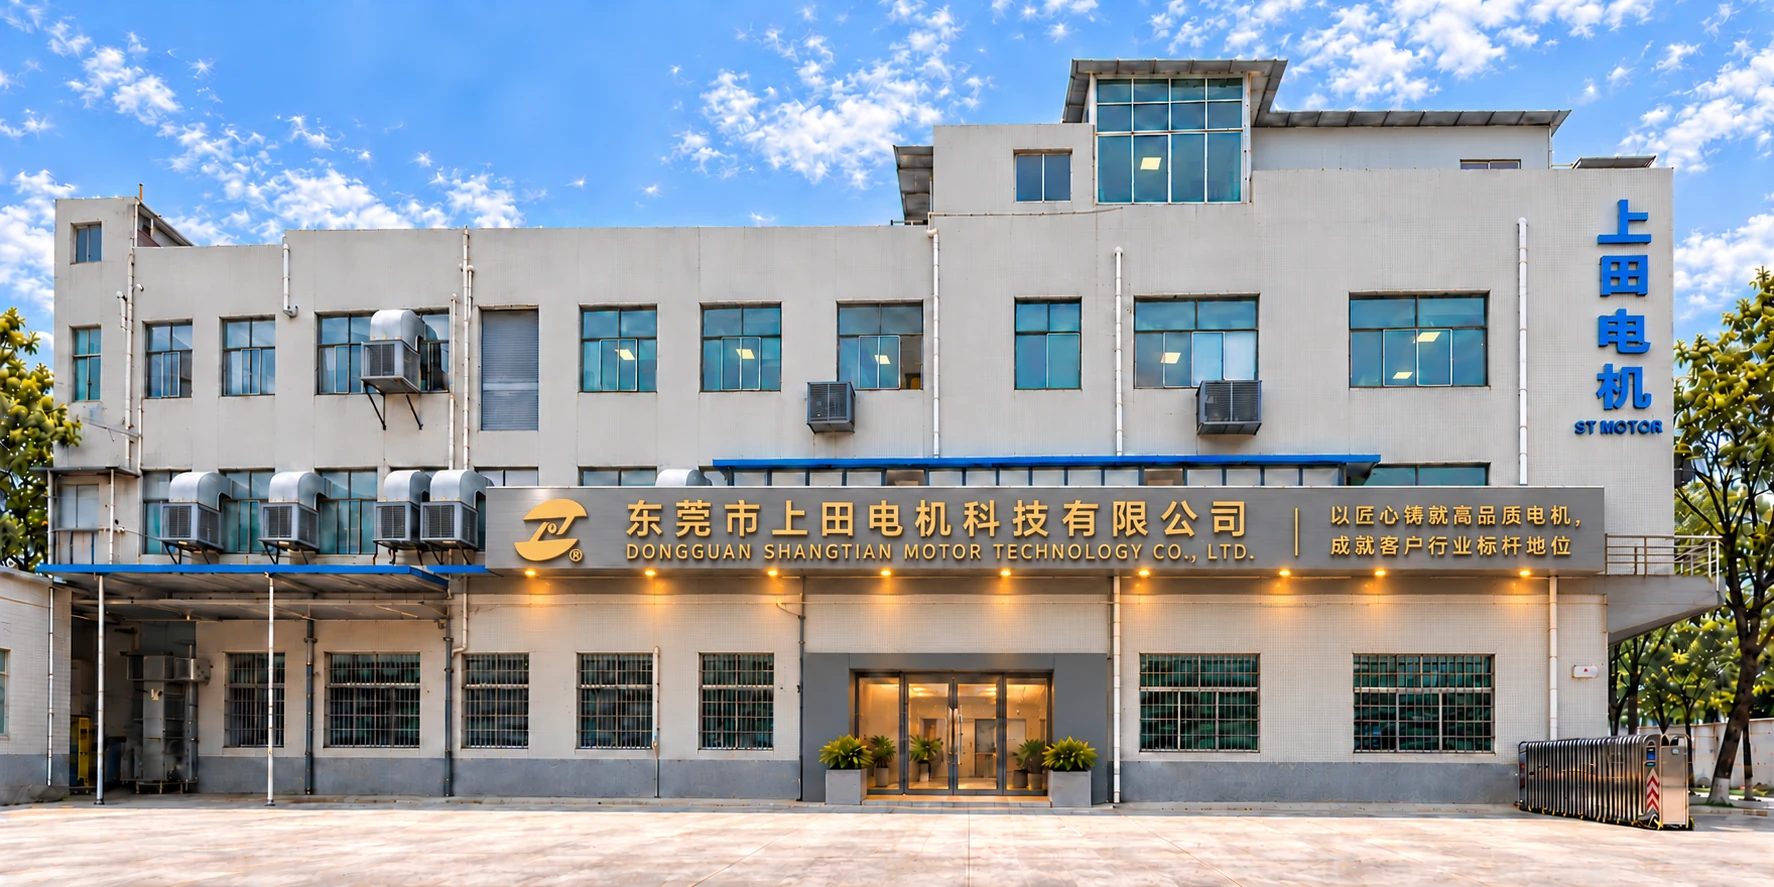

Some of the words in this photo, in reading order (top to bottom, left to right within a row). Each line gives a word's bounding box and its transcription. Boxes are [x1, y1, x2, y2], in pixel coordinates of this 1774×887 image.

[1596, 199, 1652, 410] 上田电机
[1574, 419, 1597, 435] ST
[1600, 419, 1664, 435] MOTOR
[626, 499, 1245, 538] 东莞市上田电机科技有限公司
[626, 543, 752, 560] DONGGUAN
[763, 543, 892, 560] SHANGTIAN
[903, 543, 982, 560] MOTOR
[993, 543, 1141, 560] TECHNOLOGY
[1152, 543, 1198, 564] CO.,
[1207, 543, 1255, 560] LTD.
[1330, 535, 1572, 556] 成就客户行业标杆地位
